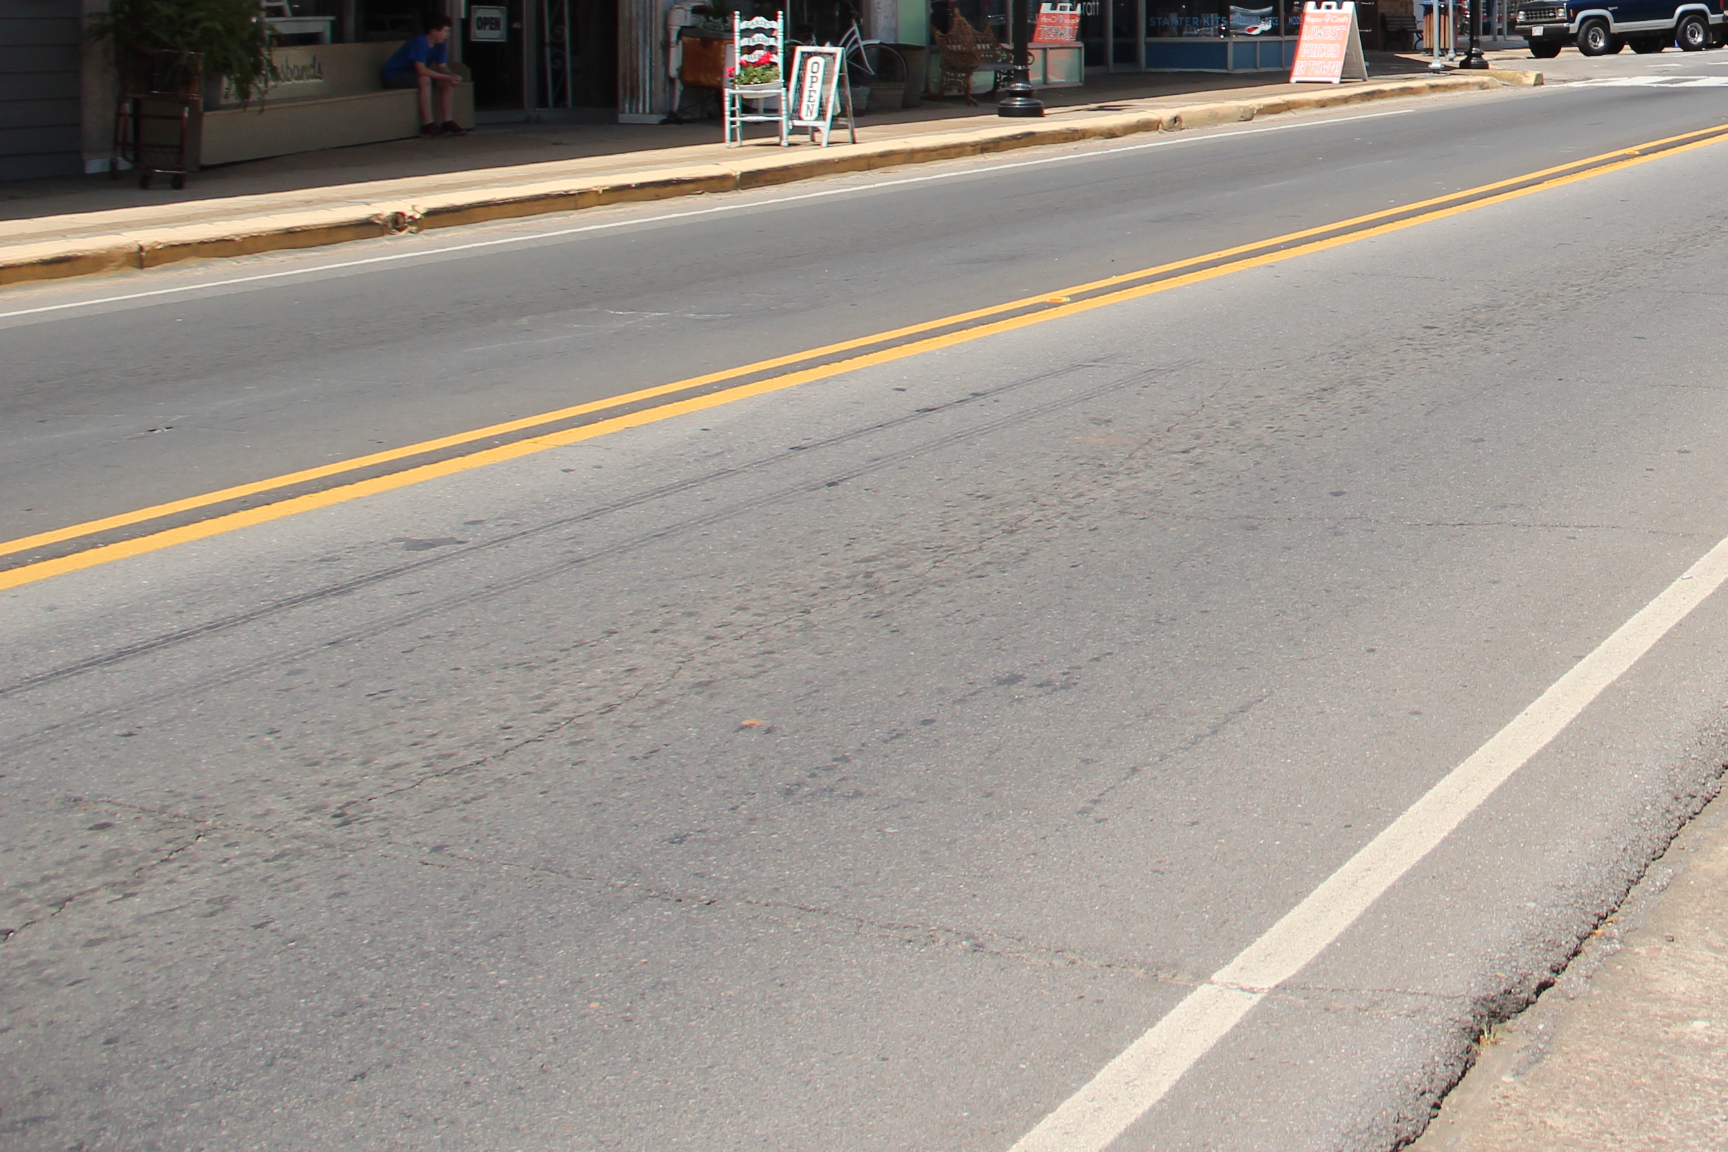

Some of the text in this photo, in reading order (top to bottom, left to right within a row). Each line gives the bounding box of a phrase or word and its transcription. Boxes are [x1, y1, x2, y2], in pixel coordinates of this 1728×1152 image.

[475, 16, 501, 31] OPEN
[1150, 16, 1198, 26] STARTER
[1202, 16, 1227, 26] KITS
[1302, 25, 1346, 40] LOWEST
[1301, 43, 1340, 57] PRICES
[805, 61, 821, 118] OPEN
